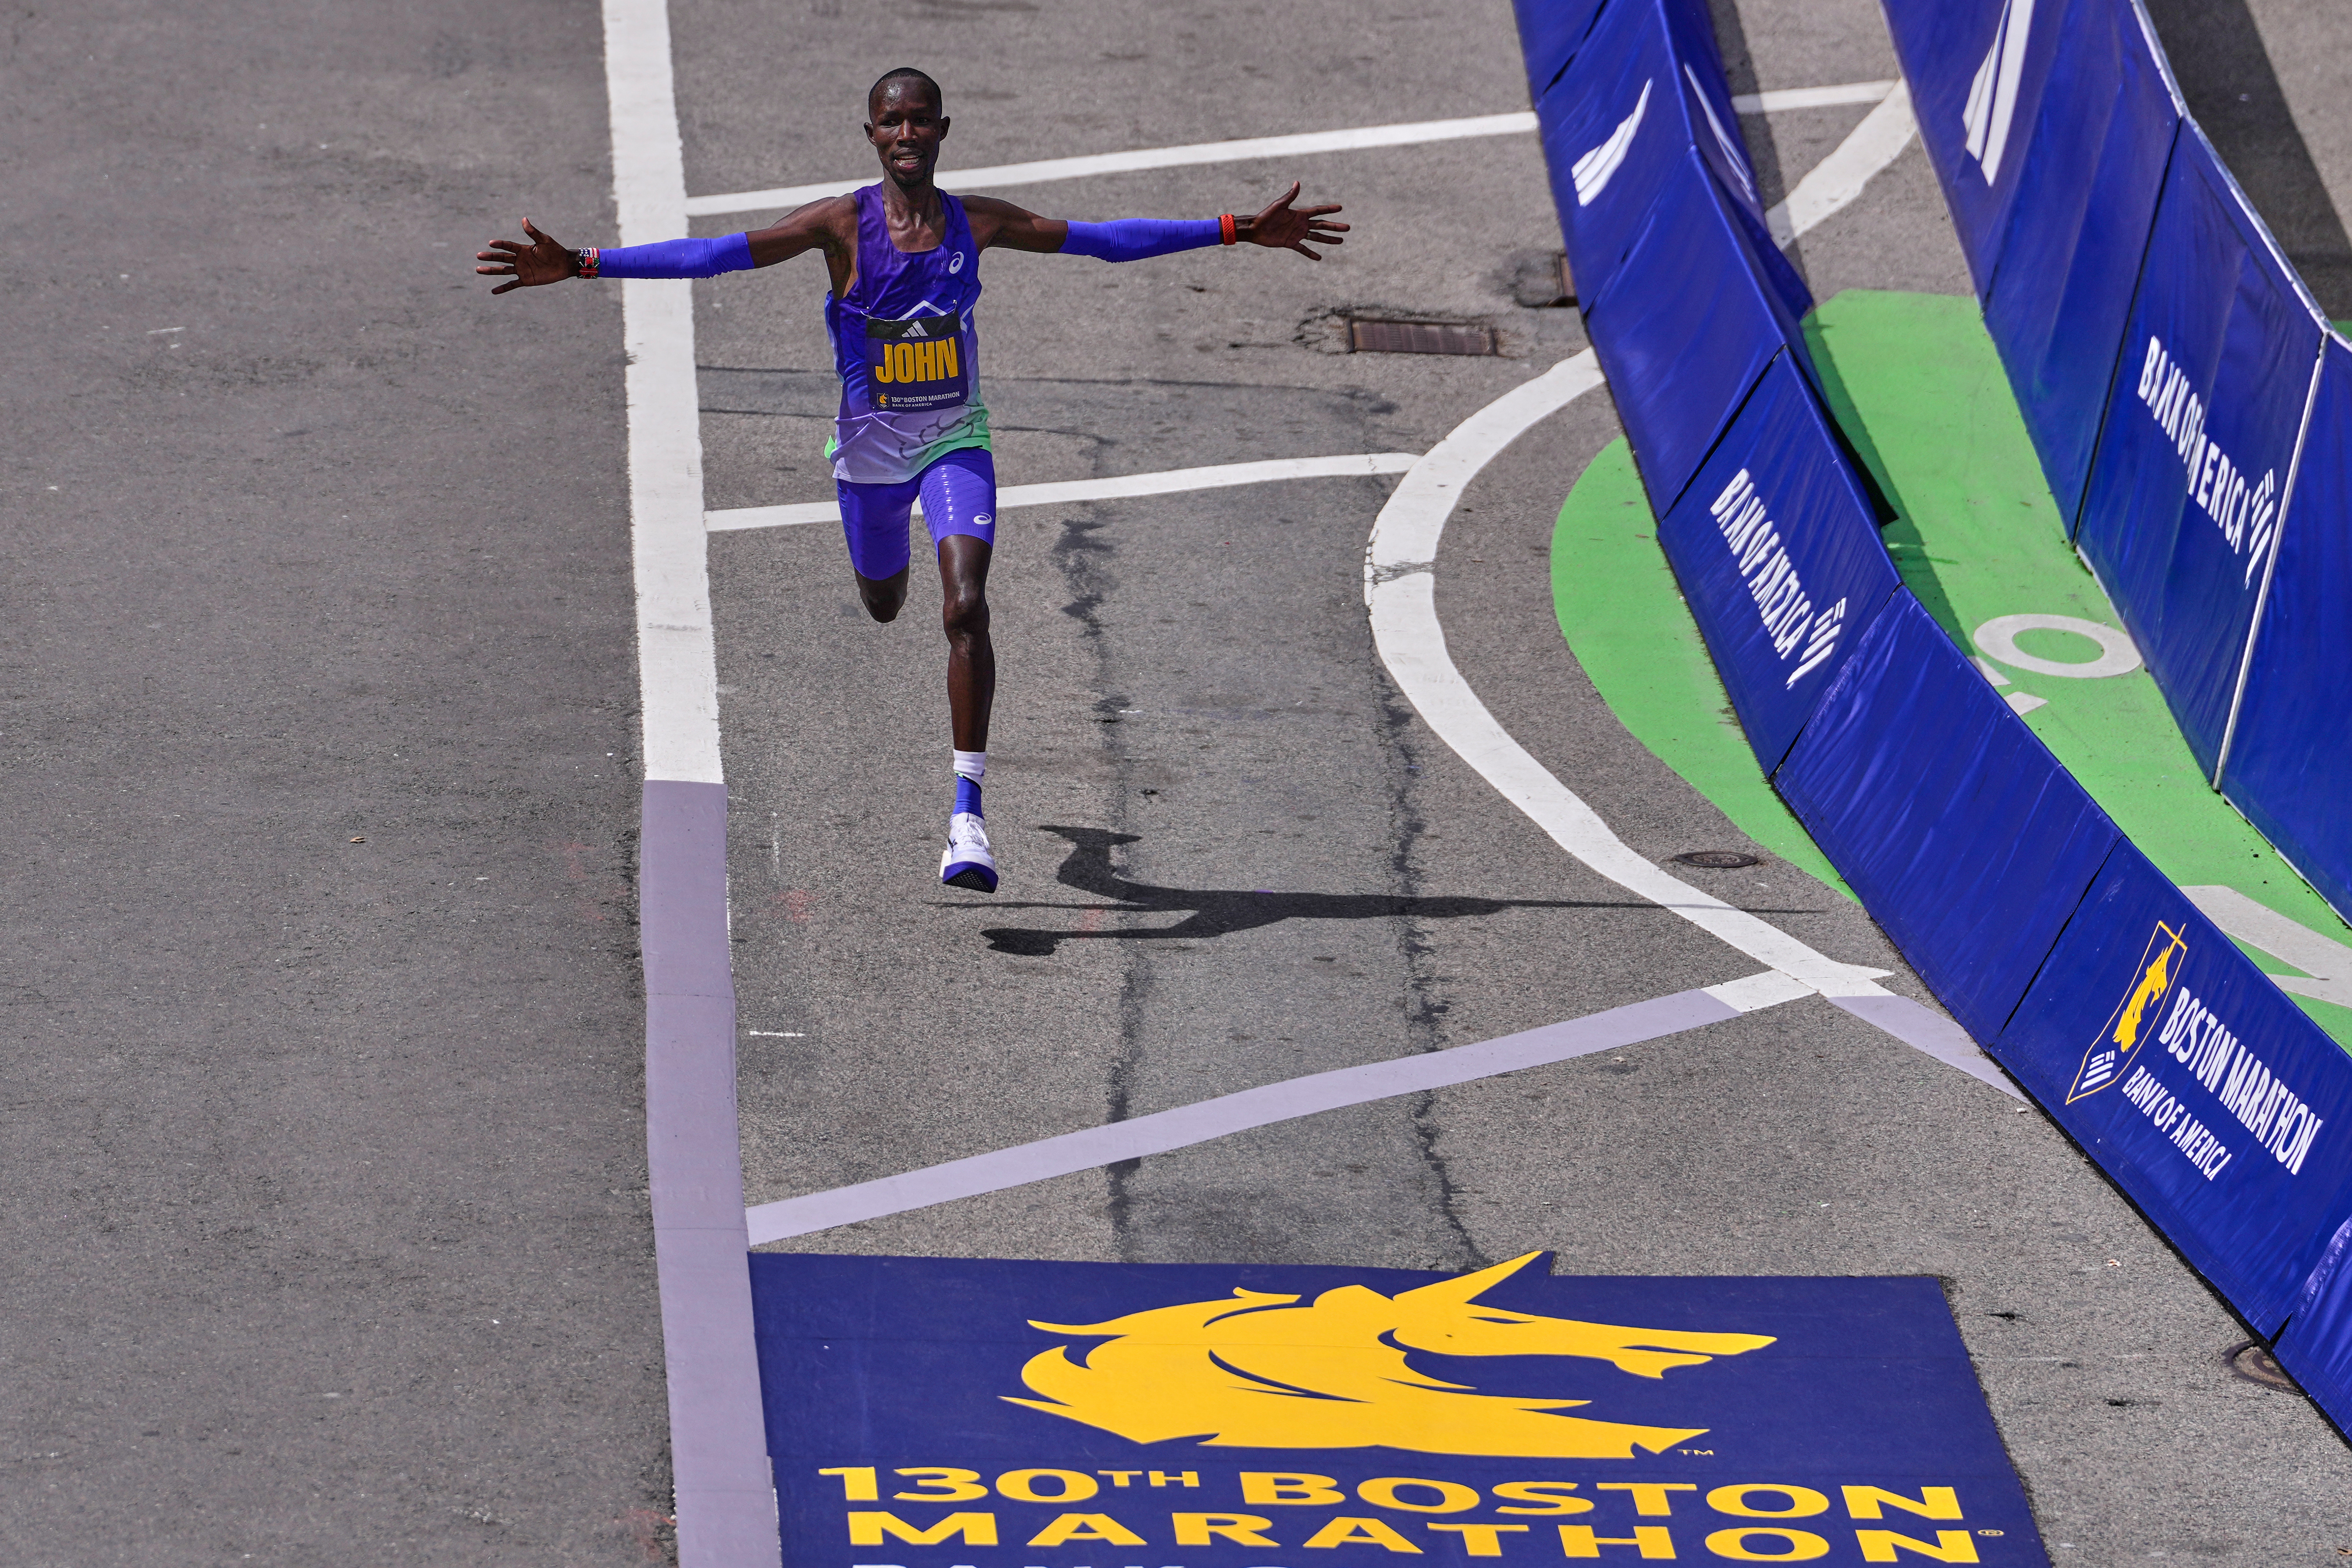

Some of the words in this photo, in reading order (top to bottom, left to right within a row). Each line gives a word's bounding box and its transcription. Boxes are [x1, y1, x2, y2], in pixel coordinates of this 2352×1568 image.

[875, 336, 958, 383] JOHN
[928, 391, 960, 401] MARATHON
[2138, 335, 2190, 442] BANK
[2178, 392, 2203, 464] OF
[1710, 468, 1766, 556] BANK
[1739, 520, 1780, 577] OF
[1748, 546, 1814, 660] AMERICA
[2122, 1065, 2168, 1117] BANK
[2153, 1096, 2184, 1133] OF
[2169, 1113, 2232, 1181] AMERICA
[2159, 987, 2238, 1093] BOSTON
[2219, 1045, 2324, 1175] MARATHON
[818, 1466, 1200, 1503] 130TH
[1239, 1472, 1964, 1520] BOSTON
